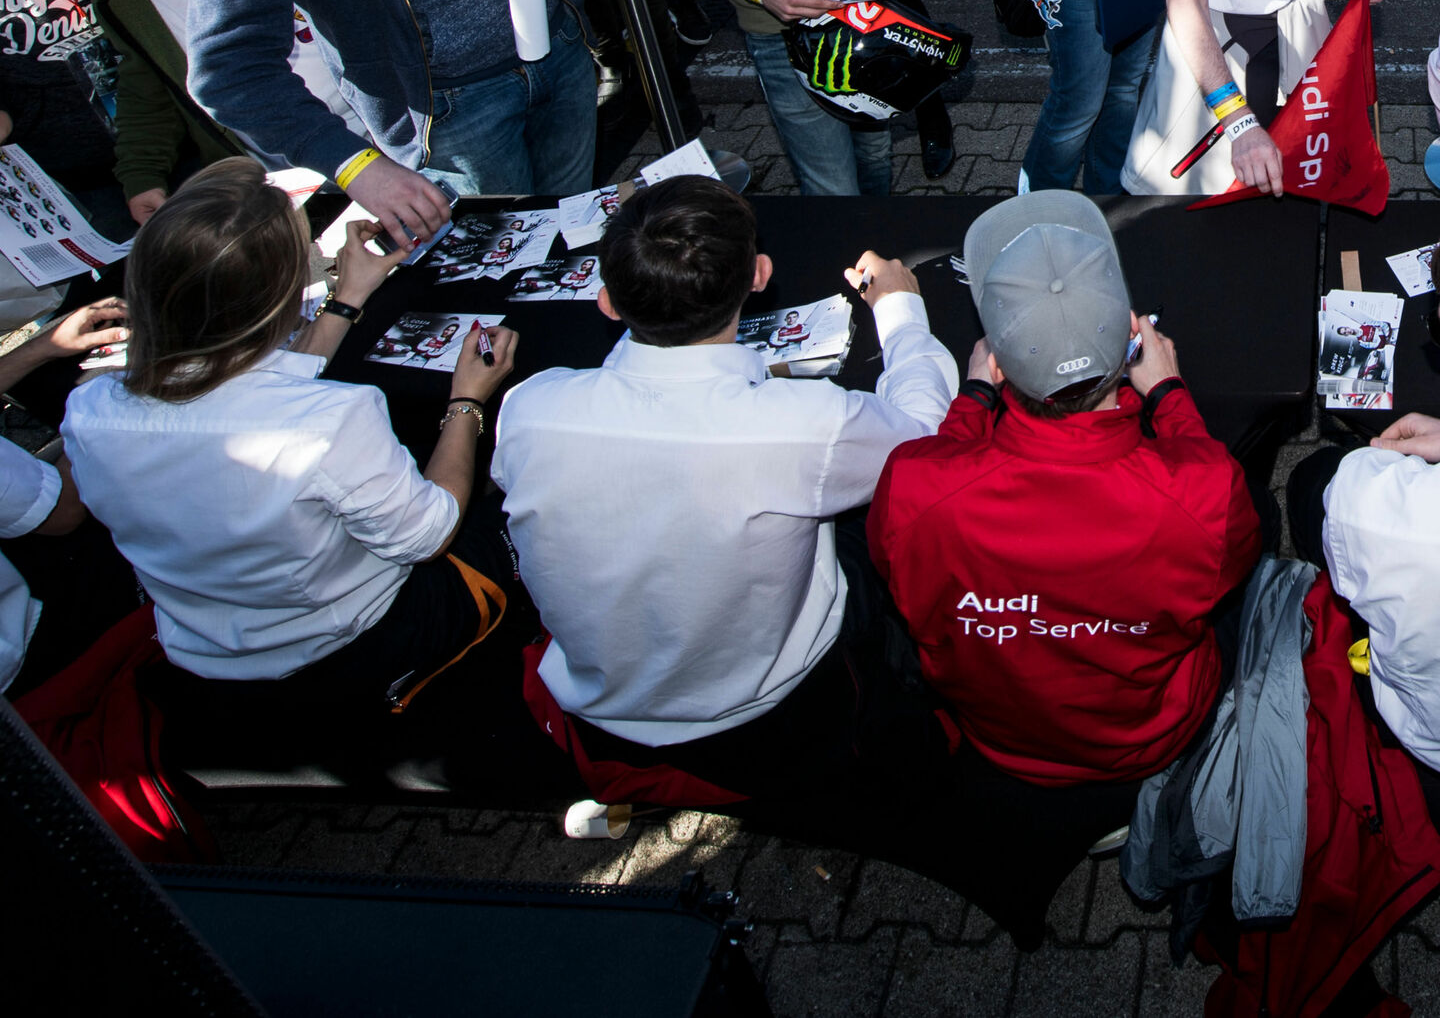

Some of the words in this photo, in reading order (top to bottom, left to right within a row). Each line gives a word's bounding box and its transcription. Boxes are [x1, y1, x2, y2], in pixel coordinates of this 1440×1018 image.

[897, 25, 940, 46] ENERGY
[868, 97, 889, 110] RPHA
[1297, 132, 1330, 189] Sp
[957, 592, 1038, 613] Audi
[957, 616, 1018, 645] Top
